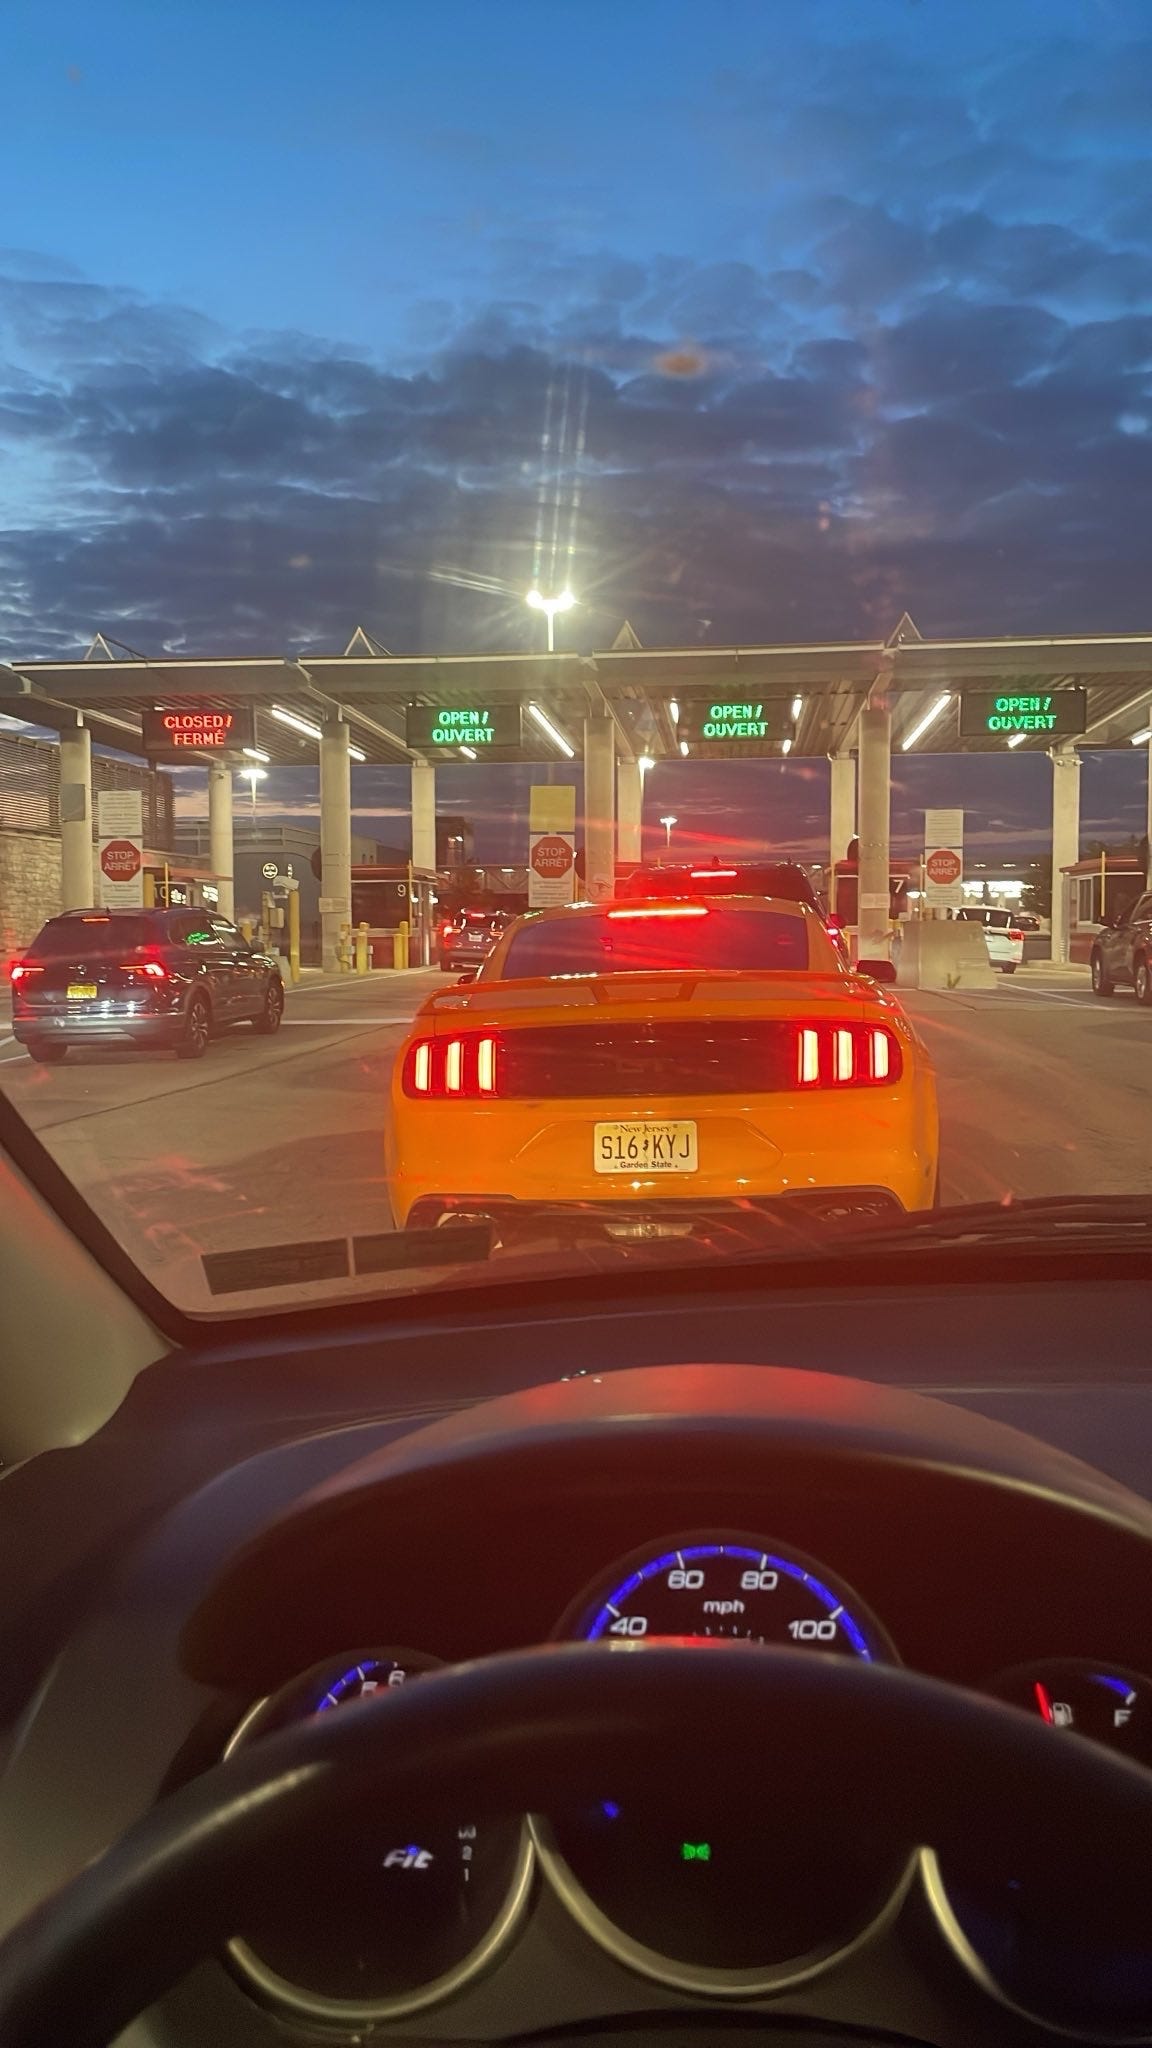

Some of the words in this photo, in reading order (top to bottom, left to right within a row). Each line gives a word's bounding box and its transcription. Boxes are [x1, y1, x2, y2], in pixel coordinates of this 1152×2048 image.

[703, 722, 768, 737] OUVERT
[988, 715, 1057, 730] OUVERT
[174, 729, 224, 745] FERMÉ
[432, 728, 495, 742] OUVERT
[107, 851, 135, 860] STOP
[537, 847, 566, 857] STOP
[931, 858, 956, 867] STOP
[397, 884, 406, 897] 9
[893, 879, 904, 893] 7
[620, 1125, 640, 1133] New
[642, 1124, 670, 1134] Jersey
[741, 1571, 778, 1590] 80
[703, 1600, 745, 1615] mph
[610, 1616, 648, 1635] 40
[788, 1620, 836, 1640] 100
[1114, 1709, 1131, 1728] F
[383, 1846, 434, 1869] Fit
[464, 1868, 470, 1881] 1
